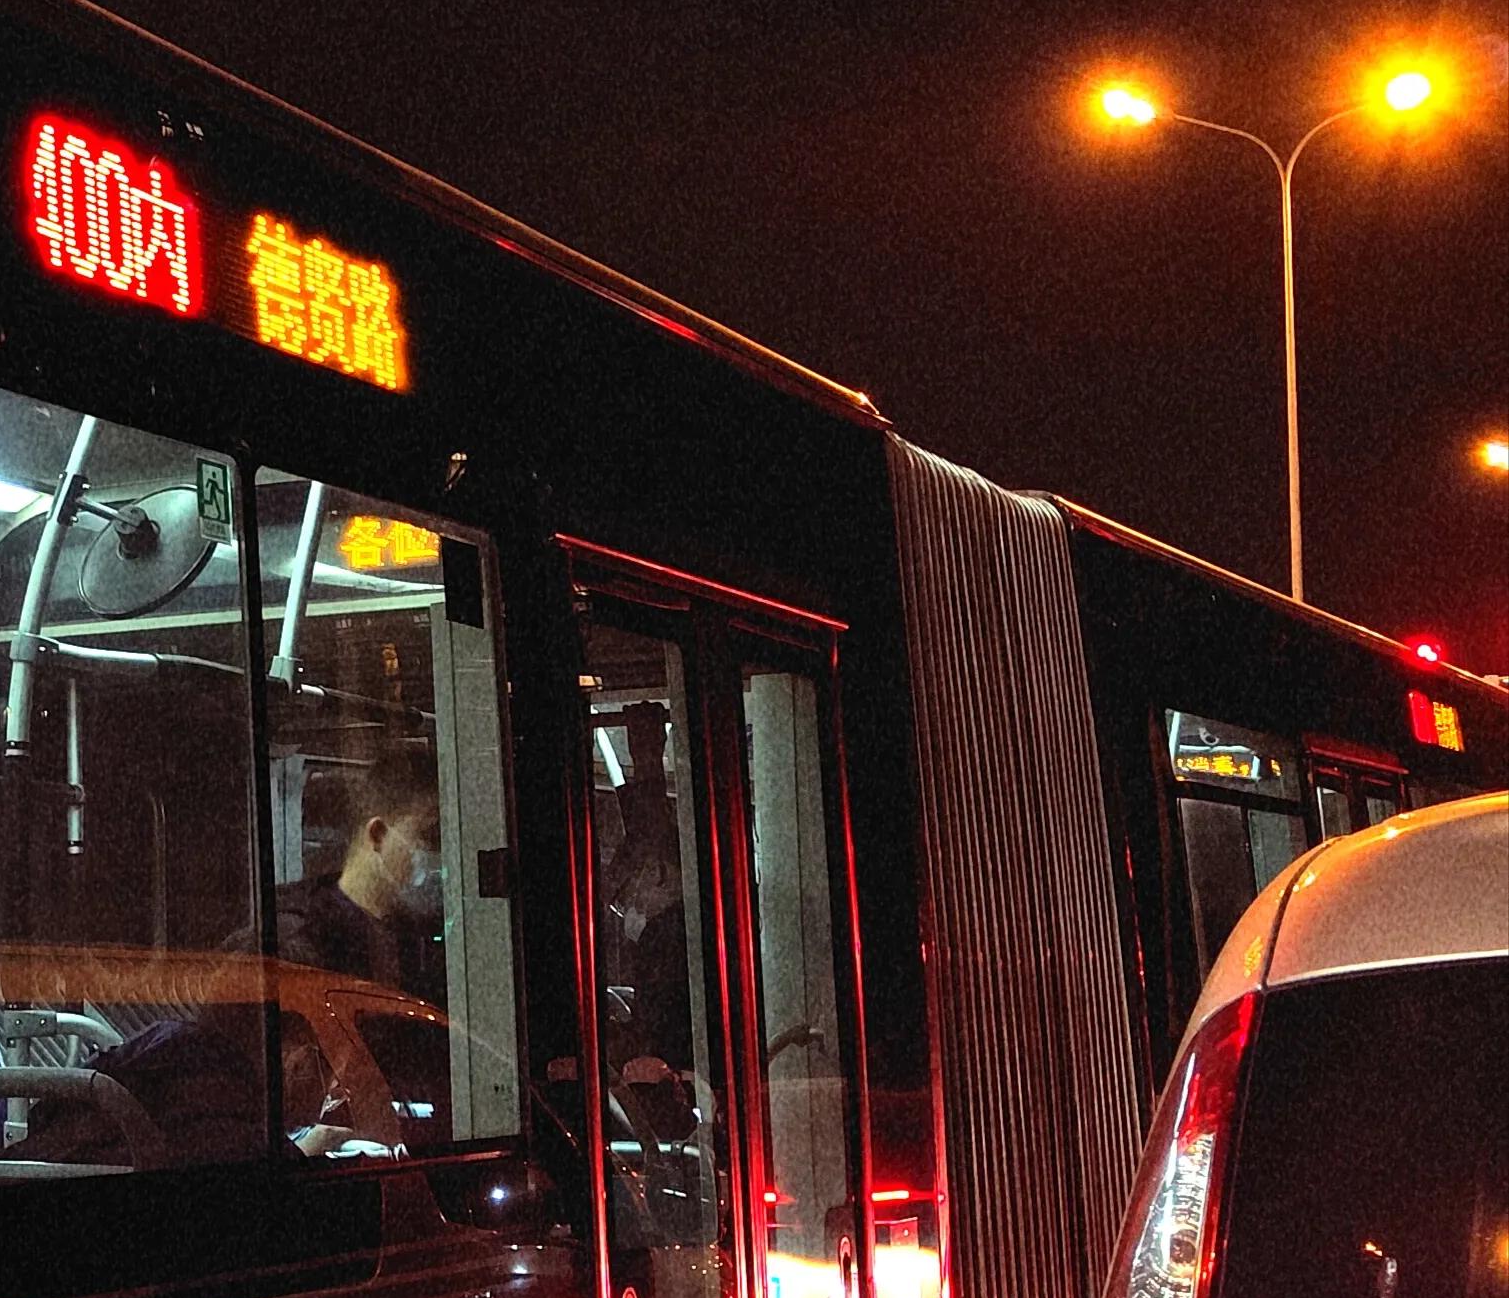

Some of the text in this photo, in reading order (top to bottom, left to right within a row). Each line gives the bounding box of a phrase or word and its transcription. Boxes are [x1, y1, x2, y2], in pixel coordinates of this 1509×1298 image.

[32, 124, 190, 313] 400内
[247, 214, 398, 390] 德贤路
